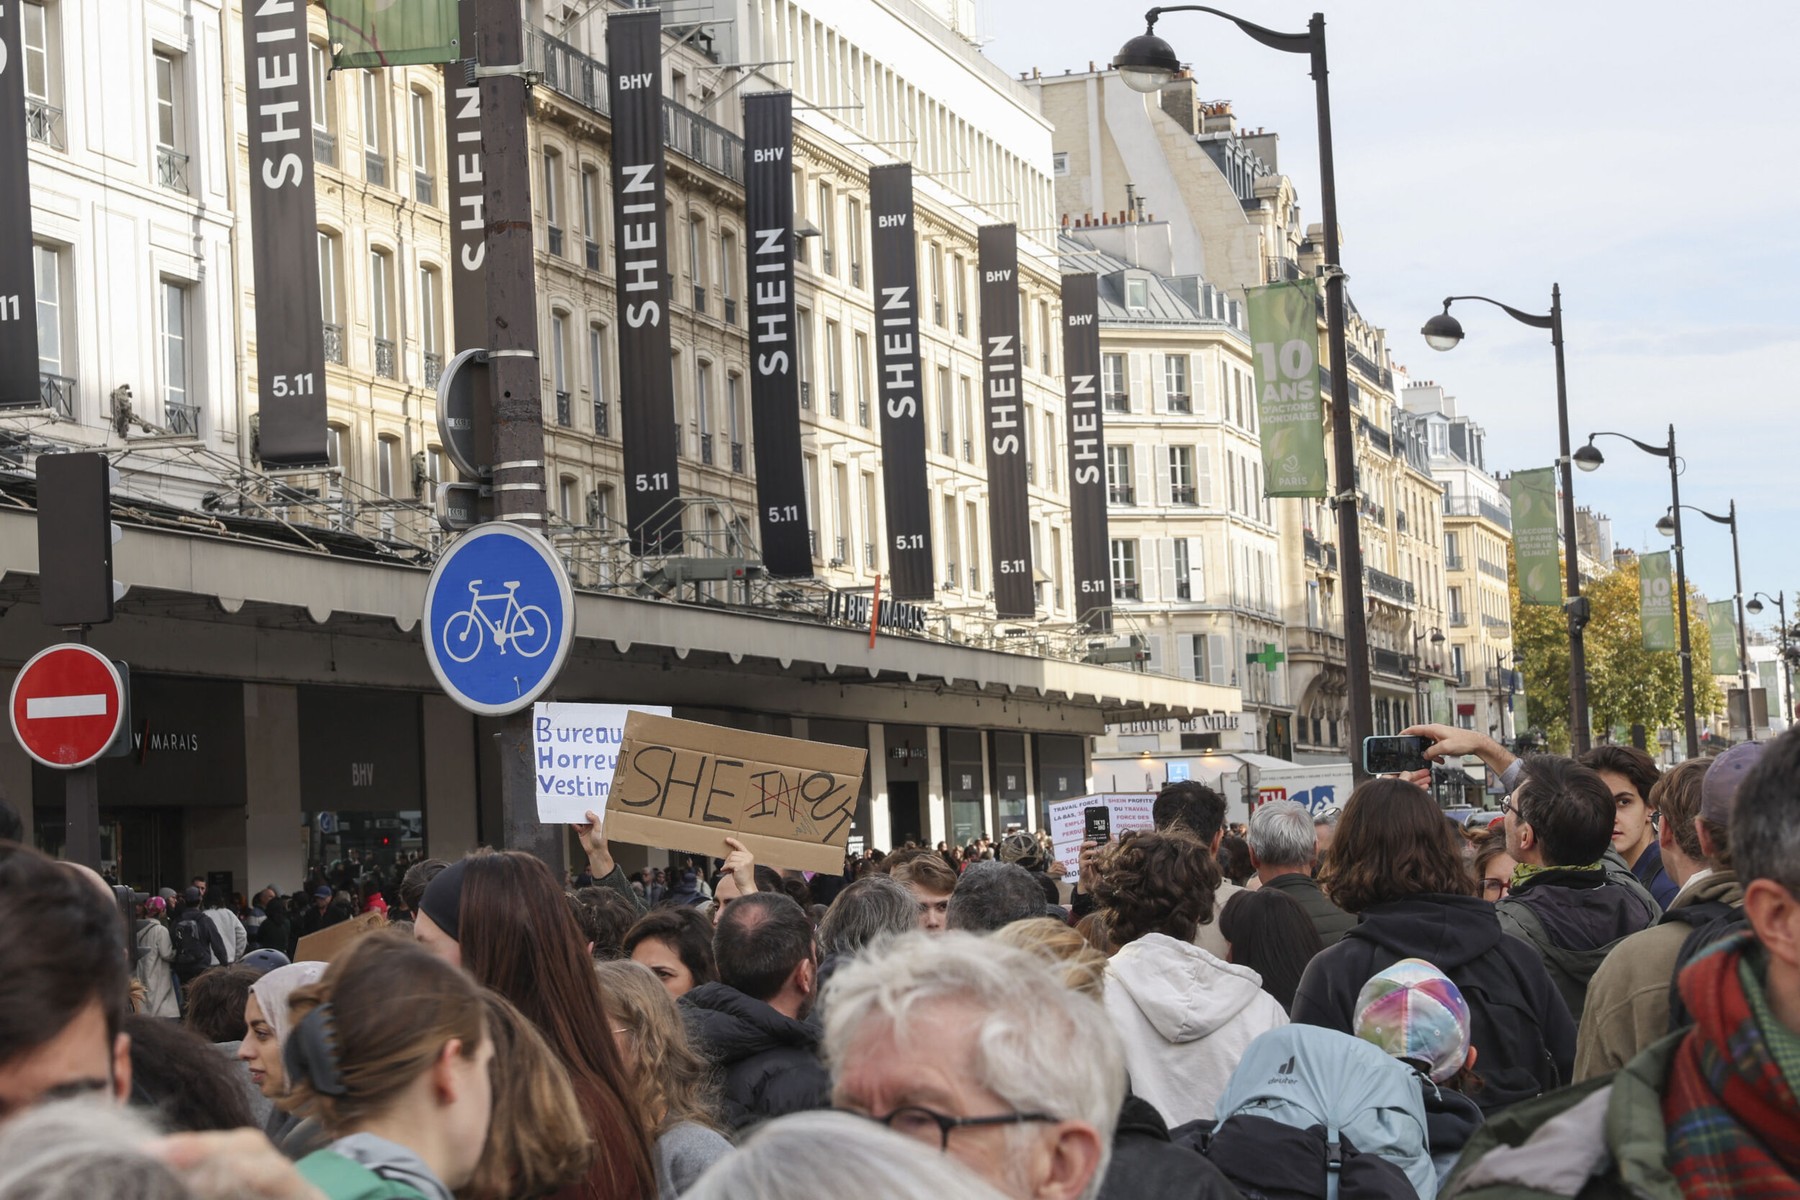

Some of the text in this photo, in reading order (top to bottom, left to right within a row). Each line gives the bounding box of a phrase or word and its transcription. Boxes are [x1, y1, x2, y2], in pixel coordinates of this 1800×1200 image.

[619, 73, 653, 90] BHV
[754, 147, 784, 163] BHV
[878, 214, 907, 228] BHV
[622, 164, 660, 328] SHEIN
[986, 269, 1012, 282] BHV
[755, 228, 789, 375] SHEIN
[1069, 314, 1093, 326] BHV
[881, 286, 916, 418] SHEIN
[1255, 339, 1313, 381] 10
[272, 373, 314, 397] 5.11
[1262, 380, 1315, 403] ANS
[989, 335, 1019, 455] SHEIN
[1262, 402, 1316, 414] D'ACTIONS
[1260, 411, 1319, 425] MONDIALES
[1071, 374, 1099, 484] SHEIN
[636, 473, 669, 492] 5.11
[1279, 477, 1308, 486] PARIS
[768, 505, 798, 523] 5.11
[896, 534, 924, 550] 5.11
[1001, 559, 1026, 574] 5.11
[1082, 580, 1105, 593] 5.11
[1641, 577, 1670, 597] 10
[536, 717, 622, 744] Bureau
[151, 733, 199, 751] MARAIS
[538, 746, 618, 770] Horreu
[352, 763, 374, 786] BHV
[538, 775, 609, 797] Vestim
[620, 746, 744, 824] SHE
[1053, 804, 1078, 813] TRAVAIL
[1062, 828, 1084, 837] PERDU
[1065, 819, 1085, 828] EMPLO
[1065, 845, 1081, 854] SHE
[1267, 1077, 1299, 1085] deuter
